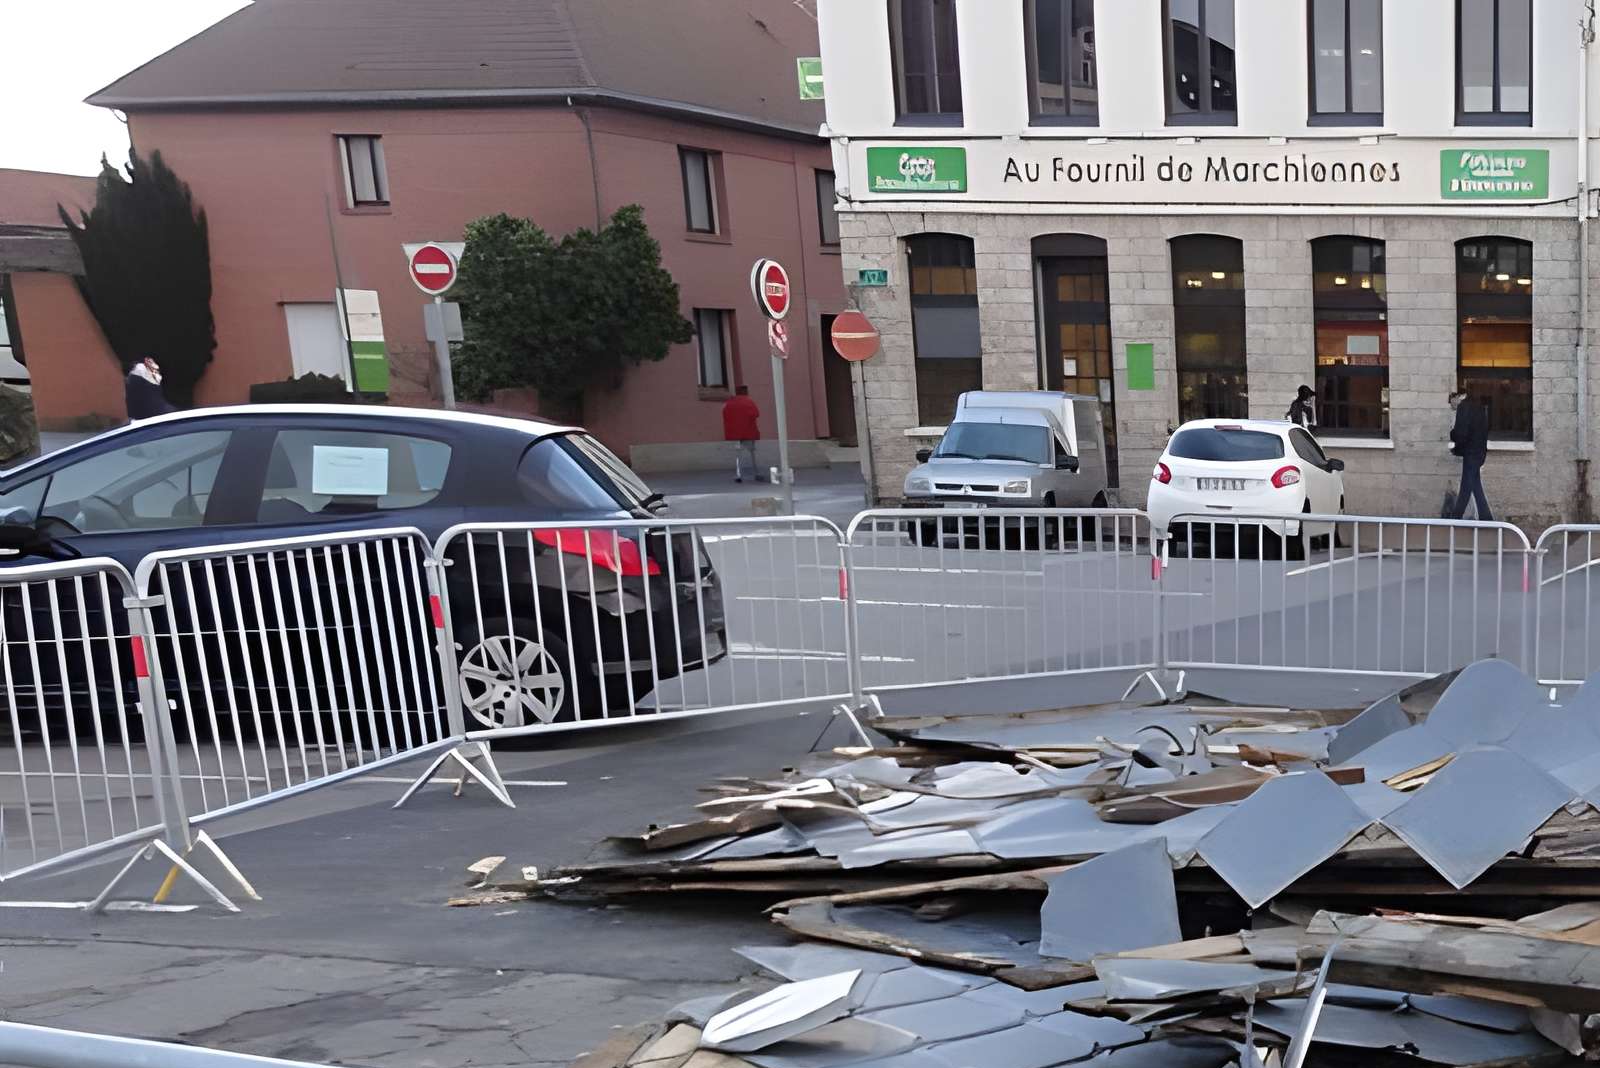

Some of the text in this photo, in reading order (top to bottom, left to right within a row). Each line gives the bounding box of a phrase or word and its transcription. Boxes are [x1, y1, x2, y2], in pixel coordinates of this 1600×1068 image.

[1003, 157, 1040, 183] Au
[1052, 153, 1145, 183] Fournil
[1157, 155, 1193, 183] de
